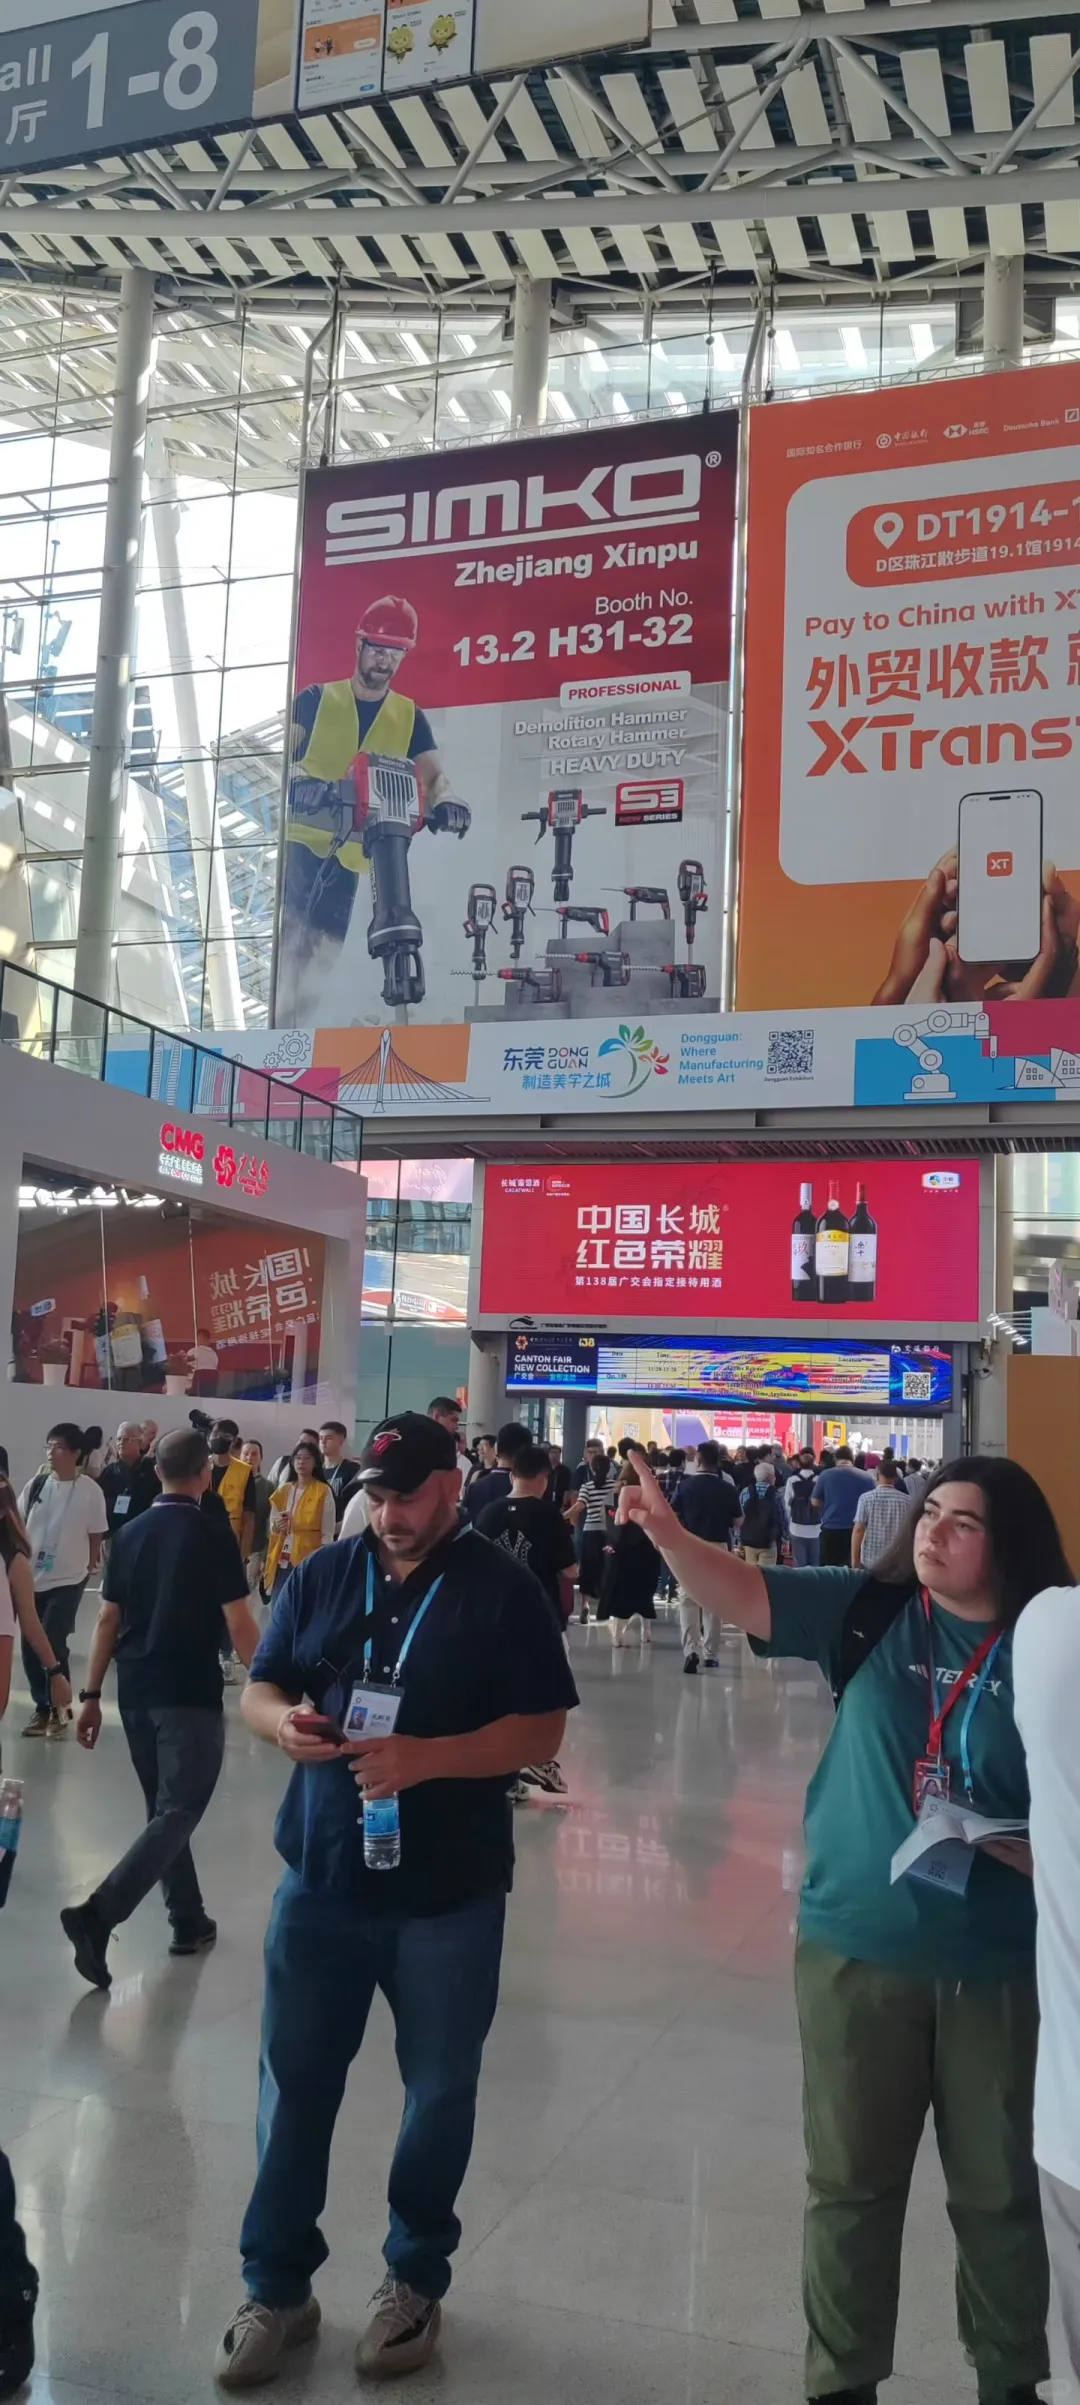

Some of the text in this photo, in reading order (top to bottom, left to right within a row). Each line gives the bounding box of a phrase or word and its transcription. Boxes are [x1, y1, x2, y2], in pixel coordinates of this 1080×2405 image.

[71, 10, 218, 130] 1-8
[4, 100, 48, 145] 厅
[785, 439, 862, 459] 国际知名合作银行
[454, 540, 698, 587] Zhejiang Xinpu
[595, 587, 694, 616] Booth No.
[805, 589, 1080, 640] Pay to China with X
[453, 613, 694, 667] 13.2 H31-32
[805, 635, 1050, 711] 外贸收款
[569, 679, 682, 700] PROFESSIONAL
[514, 708, 688, 736] Demolition Hammer
[548, 726, 687, 750] Rotary Hammer
[805, 713, 1080, 777] XTrans
[551, 749, 687, 776] HEAVY DUTY
[620, 783, 680, 812] S3
[643, 812, 678, 822] SERIES
[990, 858, 1010, 871] XT
[681, 1032, 743, 1044] Dongguan:
[503, 1047, 546, 1072] 东莞
[548, 1046, 589, 1058] DONG
[680, 1046, 717, 1057] Where
[679, 1058, 764, 1072] Manufacturing
[521, 1072, 612, 1091] 制造美学之城
[678, 1073, 735, 1085] Meets Art
[160, 1122, 205, 1160] CMG
[577, 1204, 721, 1235] 中国长城
[576, 1239, 724, 1270] 红色荣耀
[575, 1276, 723, 1289] 第138届广交会指定接待用酒
[514, 1354, 572, 1363] CANTON FAIR
[514, 1364, 591, 1374] NEW COLLECTION
